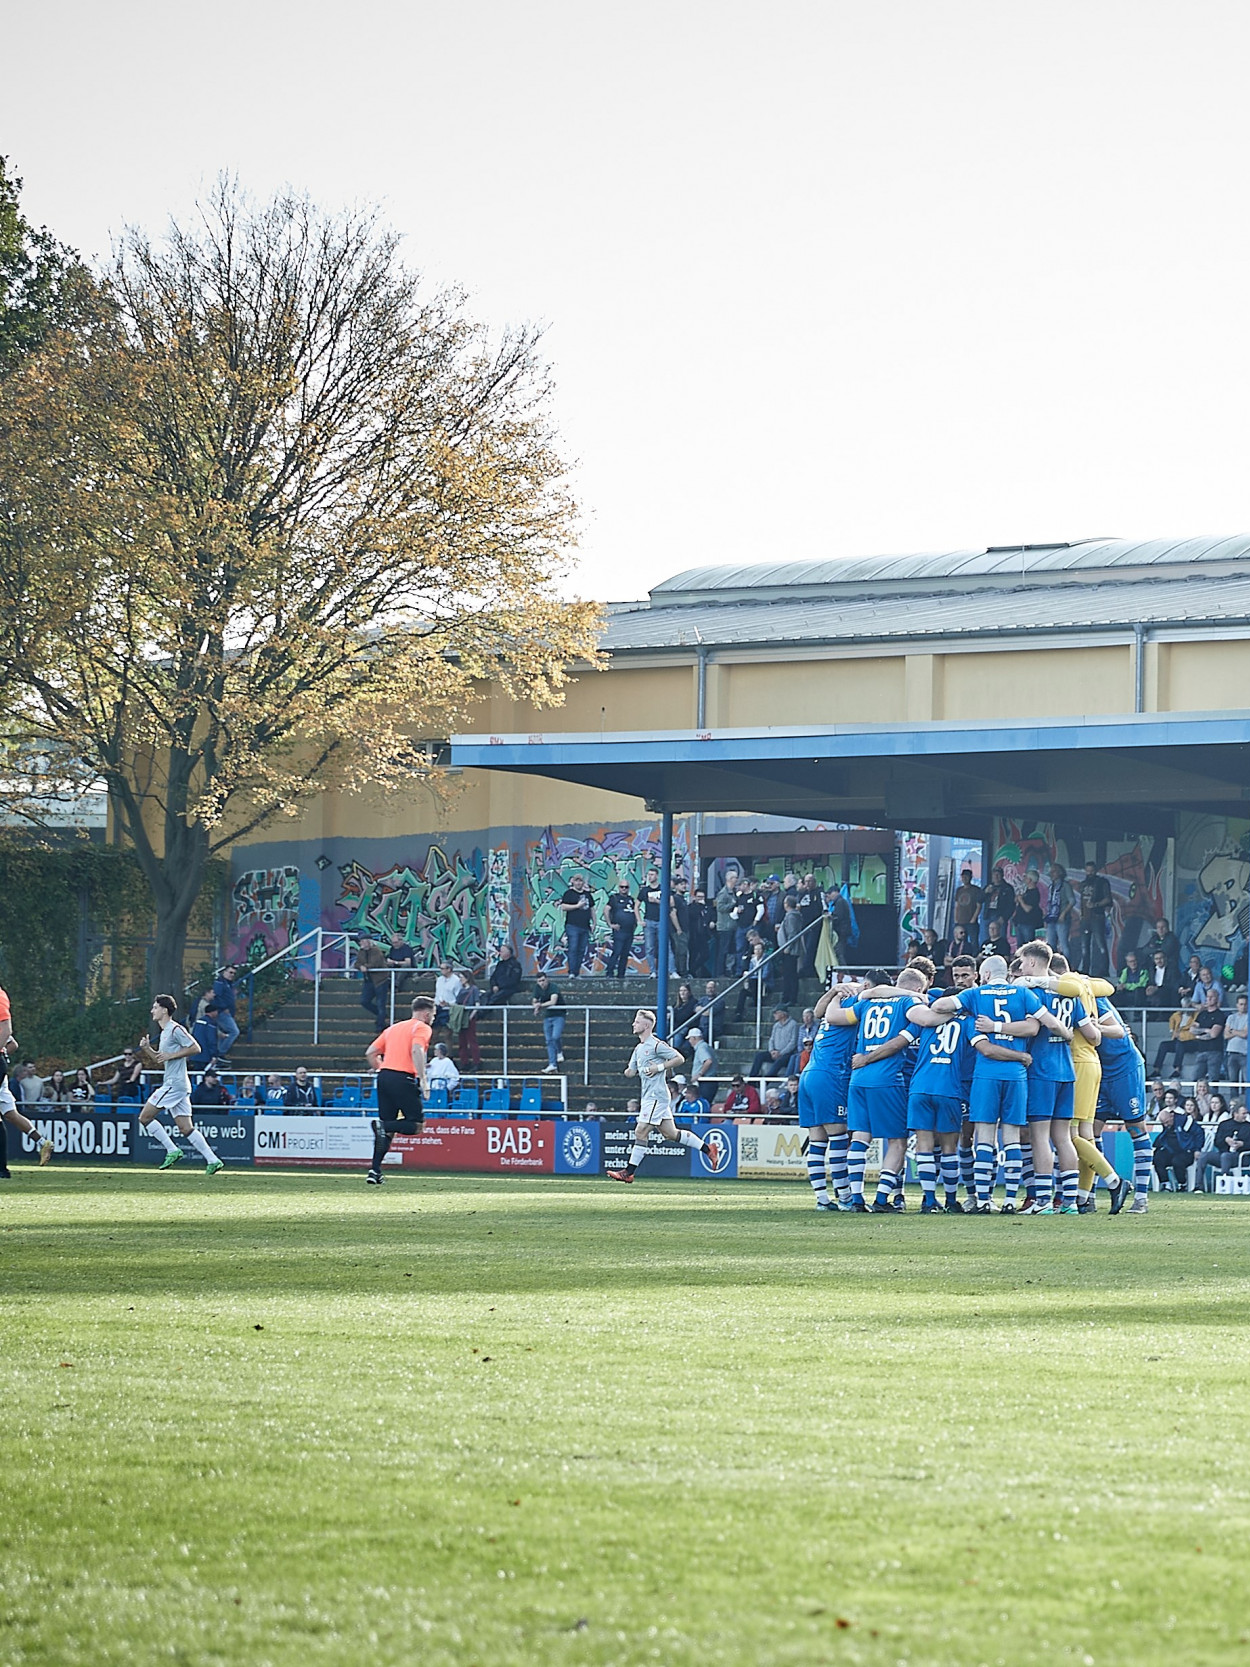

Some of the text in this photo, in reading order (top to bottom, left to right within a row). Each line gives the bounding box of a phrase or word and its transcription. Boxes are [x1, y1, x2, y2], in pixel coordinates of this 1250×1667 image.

[994, 999, 1011, 1024] 5
[864, 1006, 893, 1039] 66
[929, 1021, 961, 1054] 30
[221, 1119, 246, 1139] web
[450, 1126, 460, 1134] die
[461, 1126, 475, 1135] Fans
[604, 1130, 628, 1140] meine
[258, 1131, 286, 1149] CM1
[487, 1127, 532, 1154] BAB
[604, 1145, 626, 1154] unter
[645, 1144, 685, 1155] ochstrasse
[500, 1157, 510, 1165] Die
[604, 1158, 628, 1169] rechts
